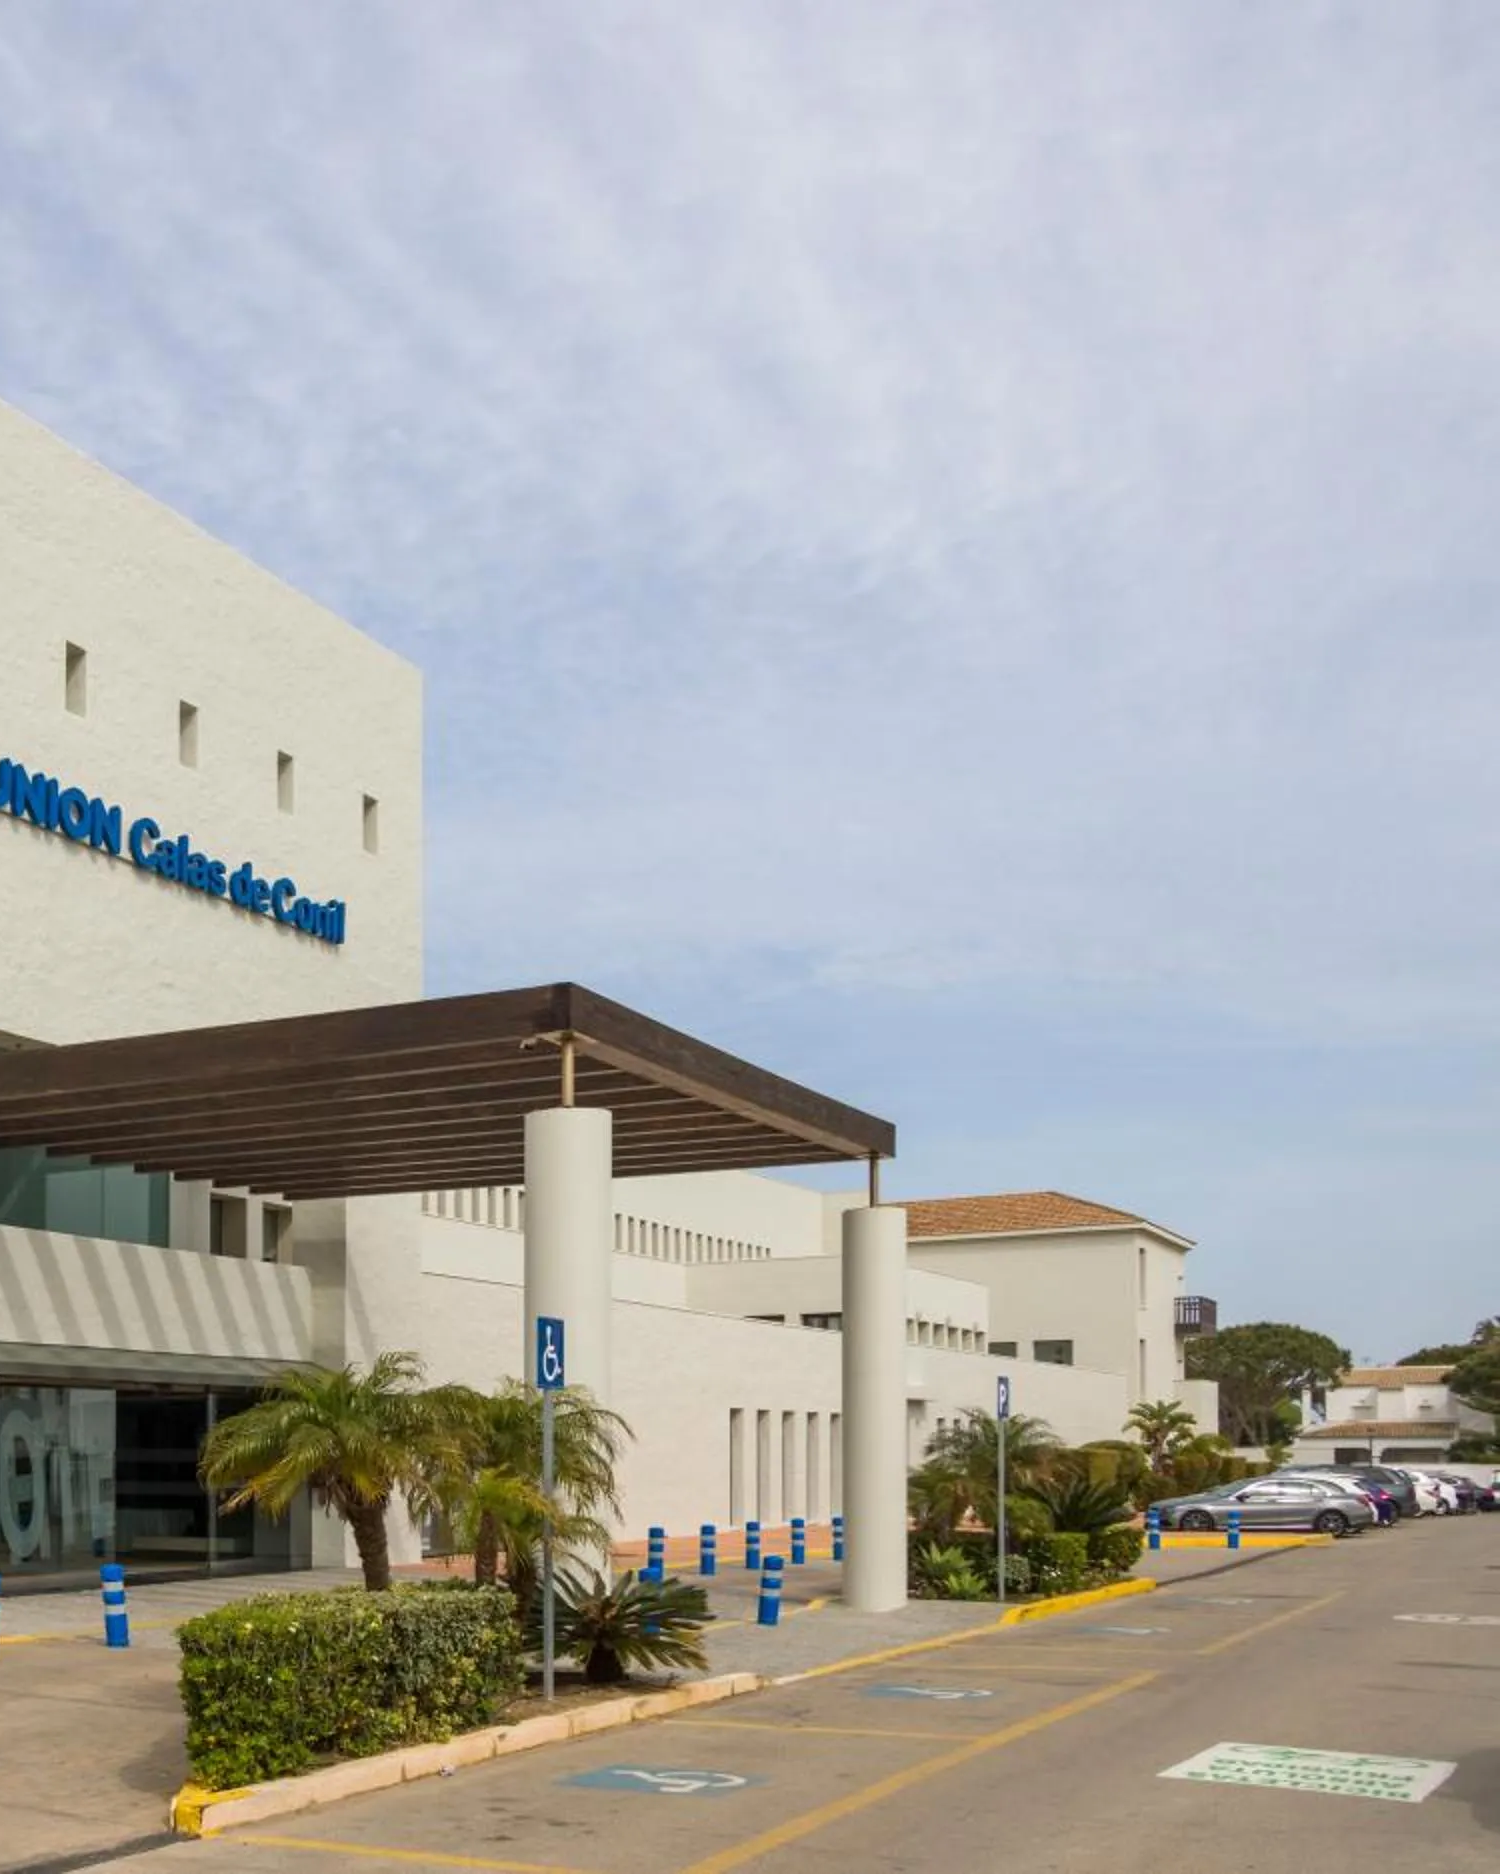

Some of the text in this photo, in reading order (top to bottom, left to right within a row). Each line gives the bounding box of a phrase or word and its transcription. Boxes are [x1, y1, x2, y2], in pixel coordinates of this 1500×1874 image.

[129, 817, 227, 896] Calas
[229, 861, 271, 913] de
[272, 877, 346, 945] Conil
